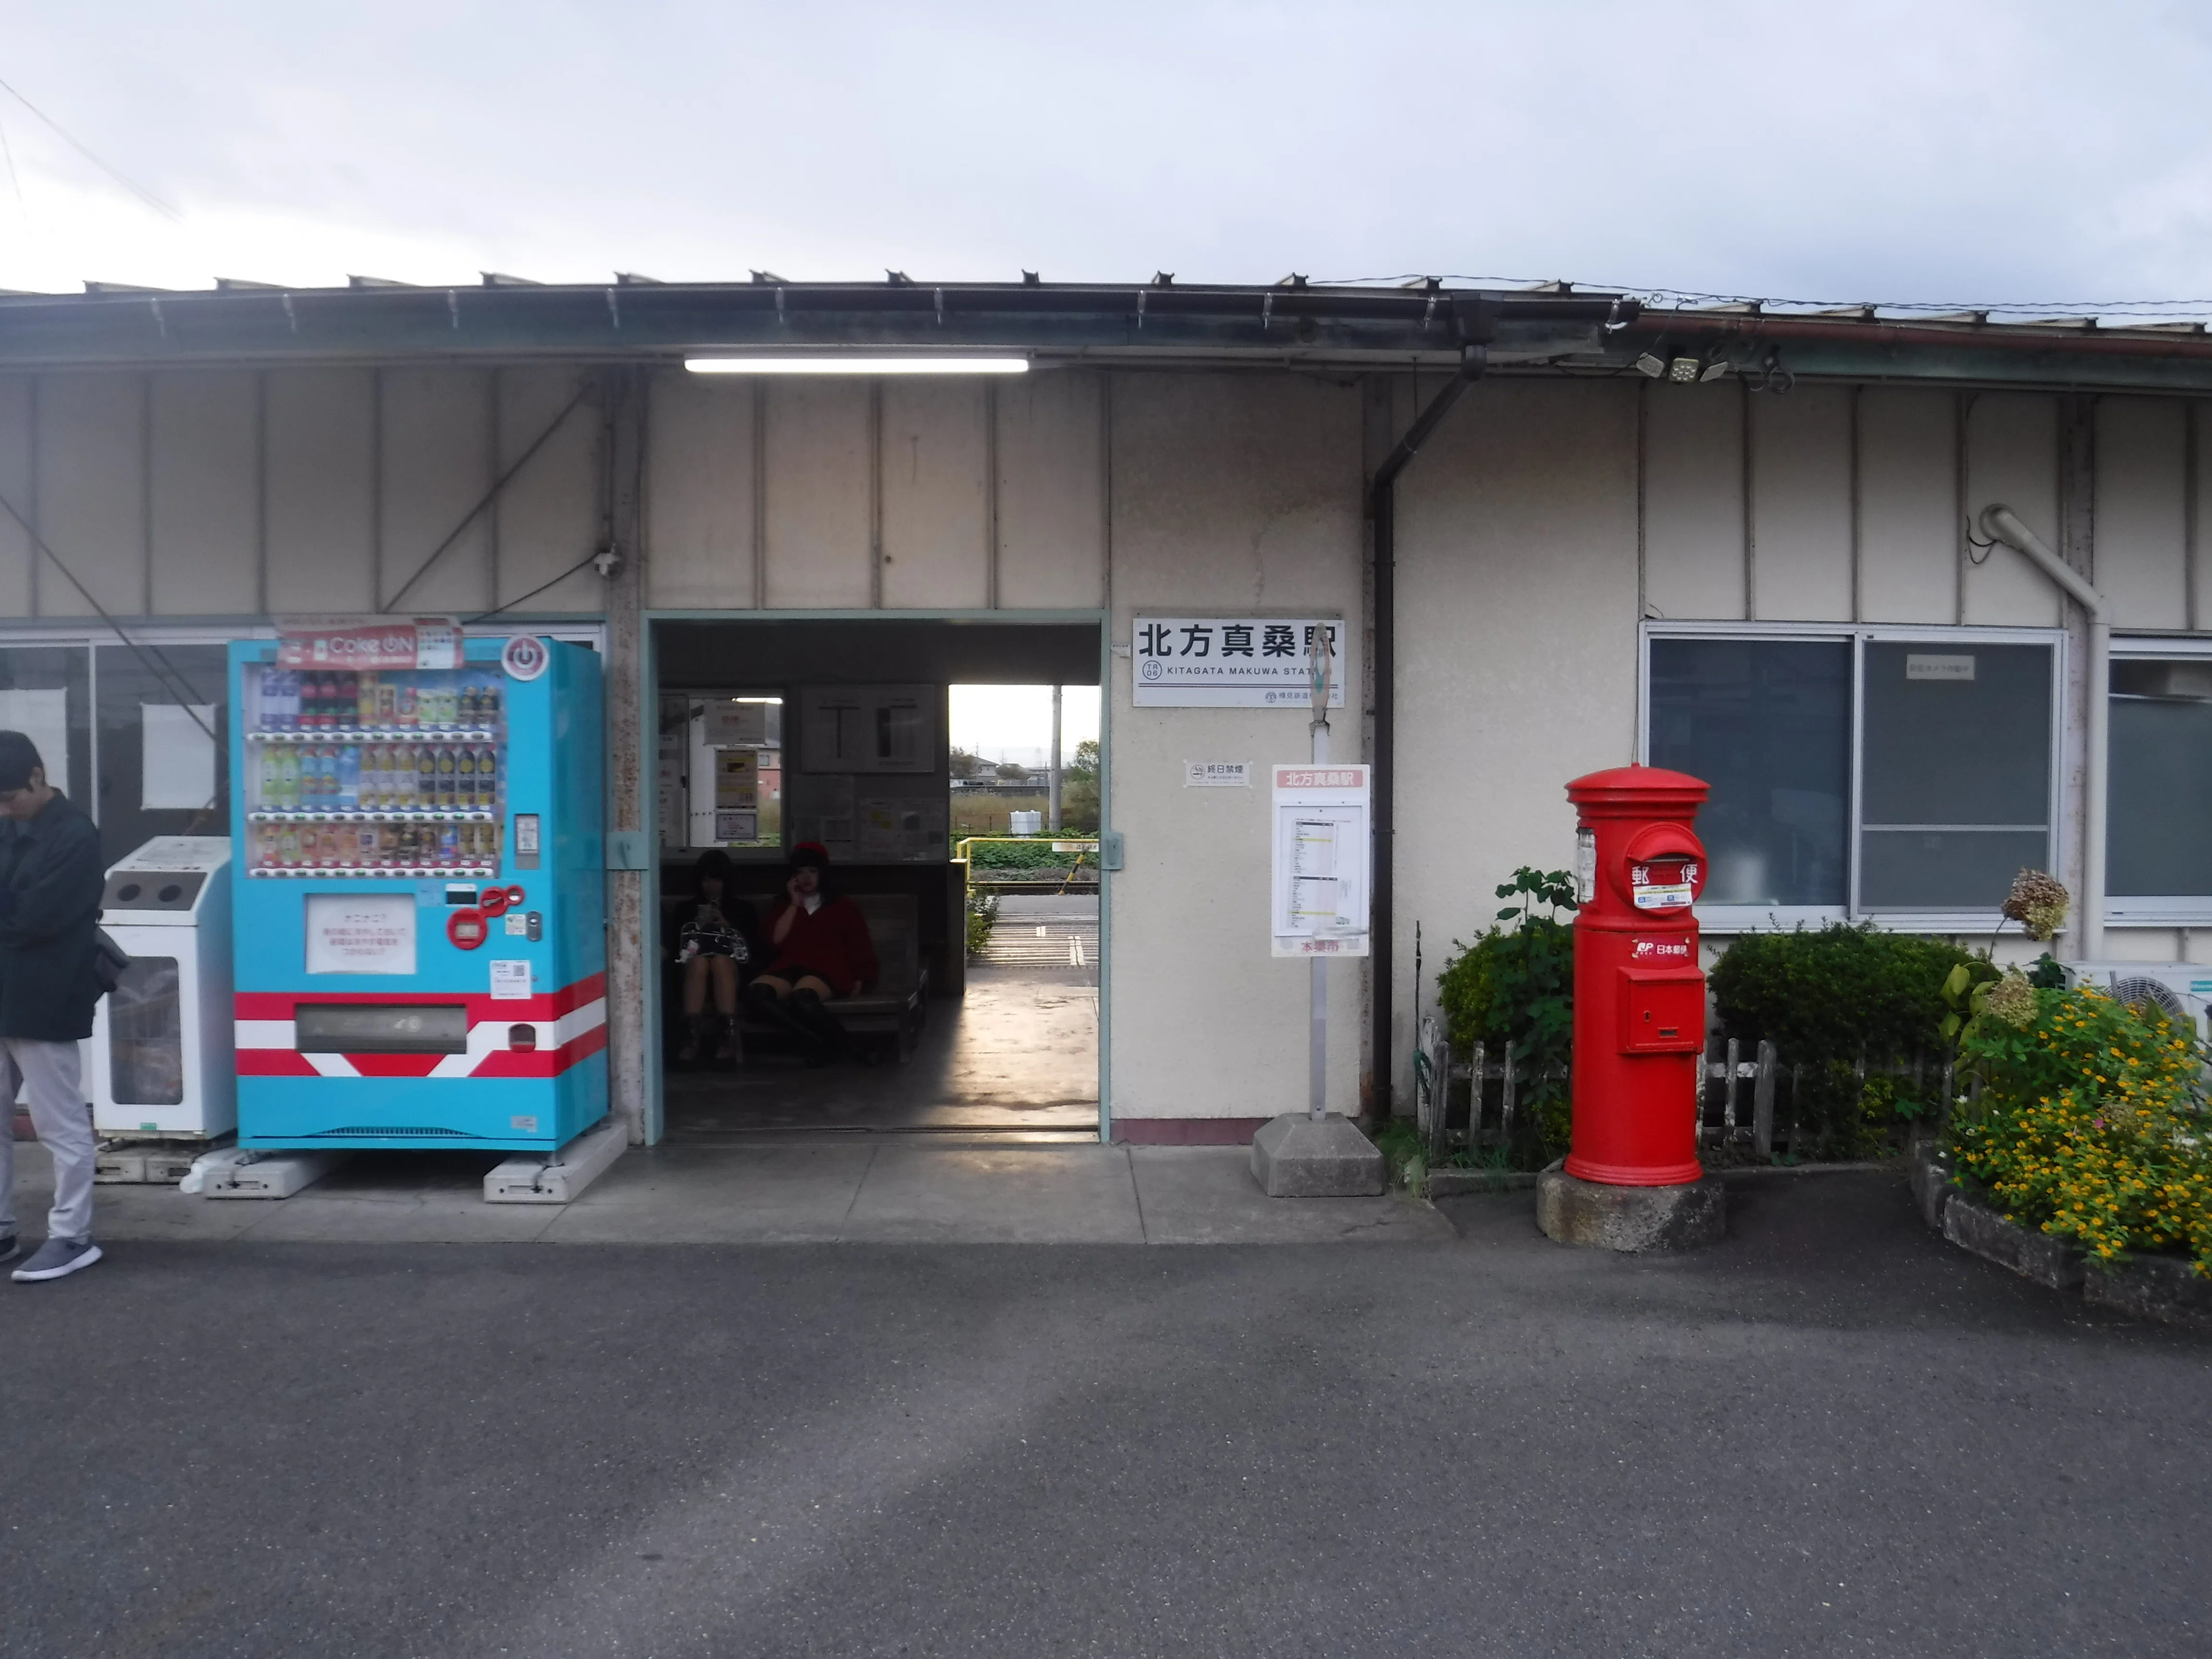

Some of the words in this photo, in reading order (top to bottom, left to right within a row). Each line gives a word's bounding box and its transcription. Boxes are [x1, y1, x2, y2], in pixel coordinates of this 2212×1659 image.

[329, 637, 379, 654] Coke
[1167, 667, 1224, 675] KITAGATA
[1207, 764, 1243, 773] 終日禁煙
[1286, 771, 1354, 786] 北方真桑駅
[1301, 941, 1339, 952] 本巣市
[1637, 942, 1654, 952] JP
[1657, 944, 1687, 954] 日本郵便
